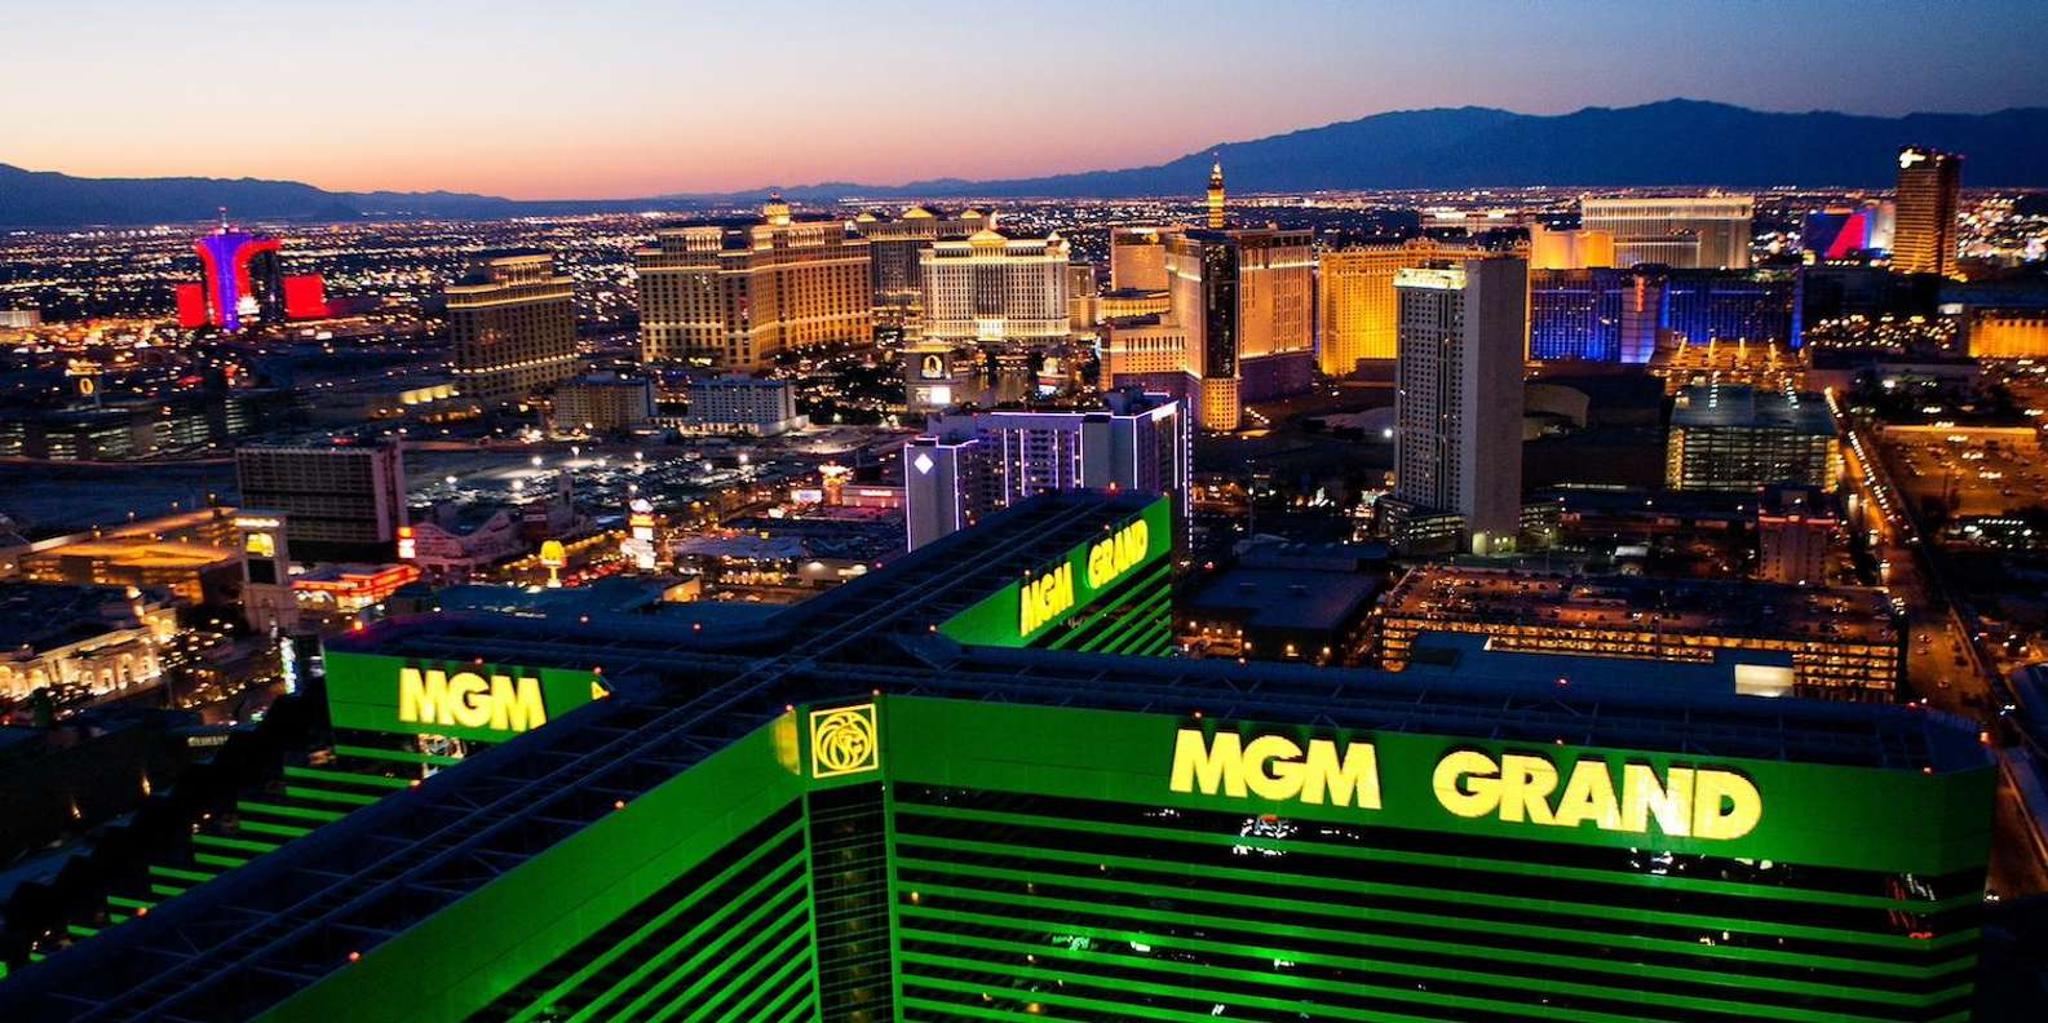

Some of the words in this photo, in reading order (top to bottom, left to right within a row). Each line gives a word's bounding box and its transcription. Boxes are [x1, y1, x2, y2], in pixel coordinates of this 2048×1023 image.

[1020, 561, 1074, 636] MGM
[1087, 519, 1148, 589] GRAND
[399, 667, 546, 732] MGM
[1169, 728, 1381, 810] MGM
[1432, 750, 1762, 841] GRAND
